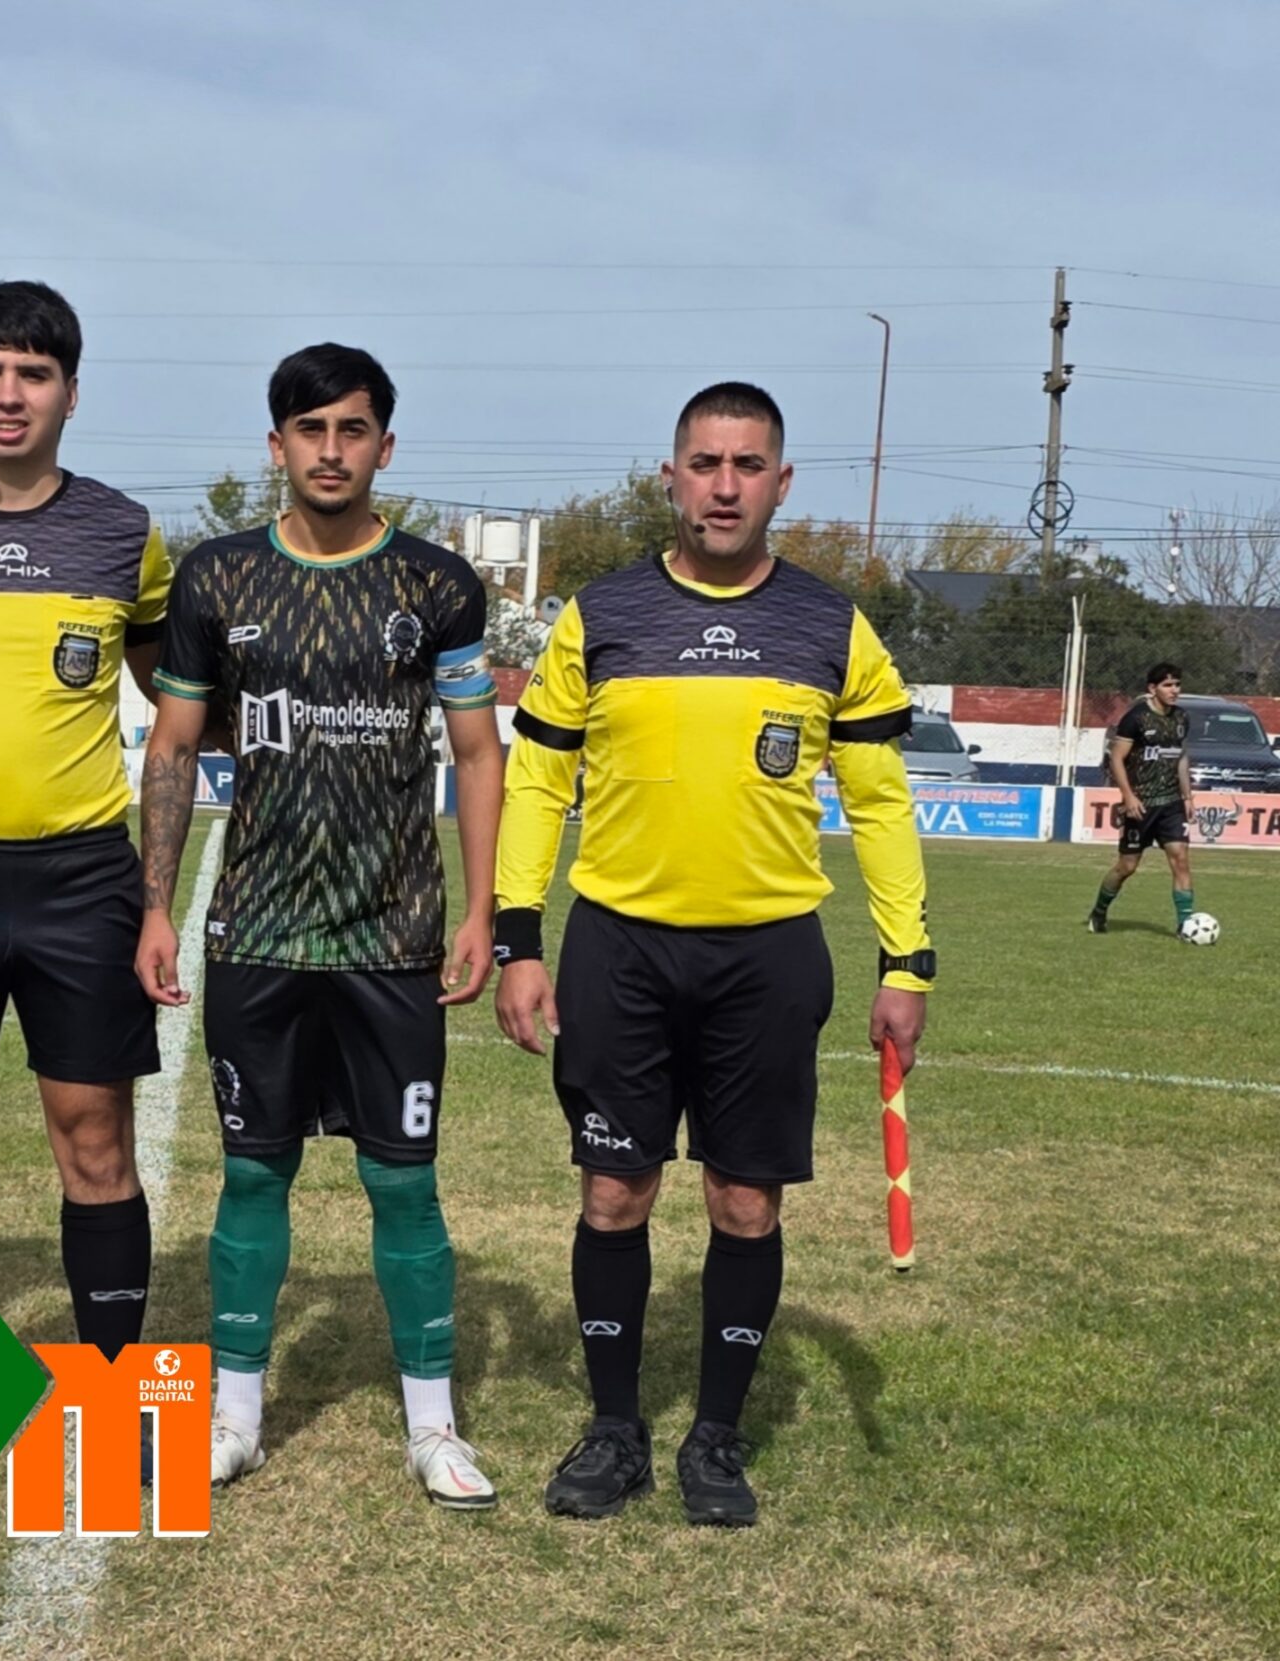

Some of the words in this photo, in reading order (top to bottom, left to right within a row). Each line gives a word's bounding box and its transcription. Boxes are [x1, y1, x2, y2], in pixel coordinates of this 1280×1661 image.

[679, 647, 761, 660] ATHIX
[293, 700, 410, 729] Premoldeados
[762, 709, 805, 725] REFEREE
[402, 1080, 434, 1138] 6
